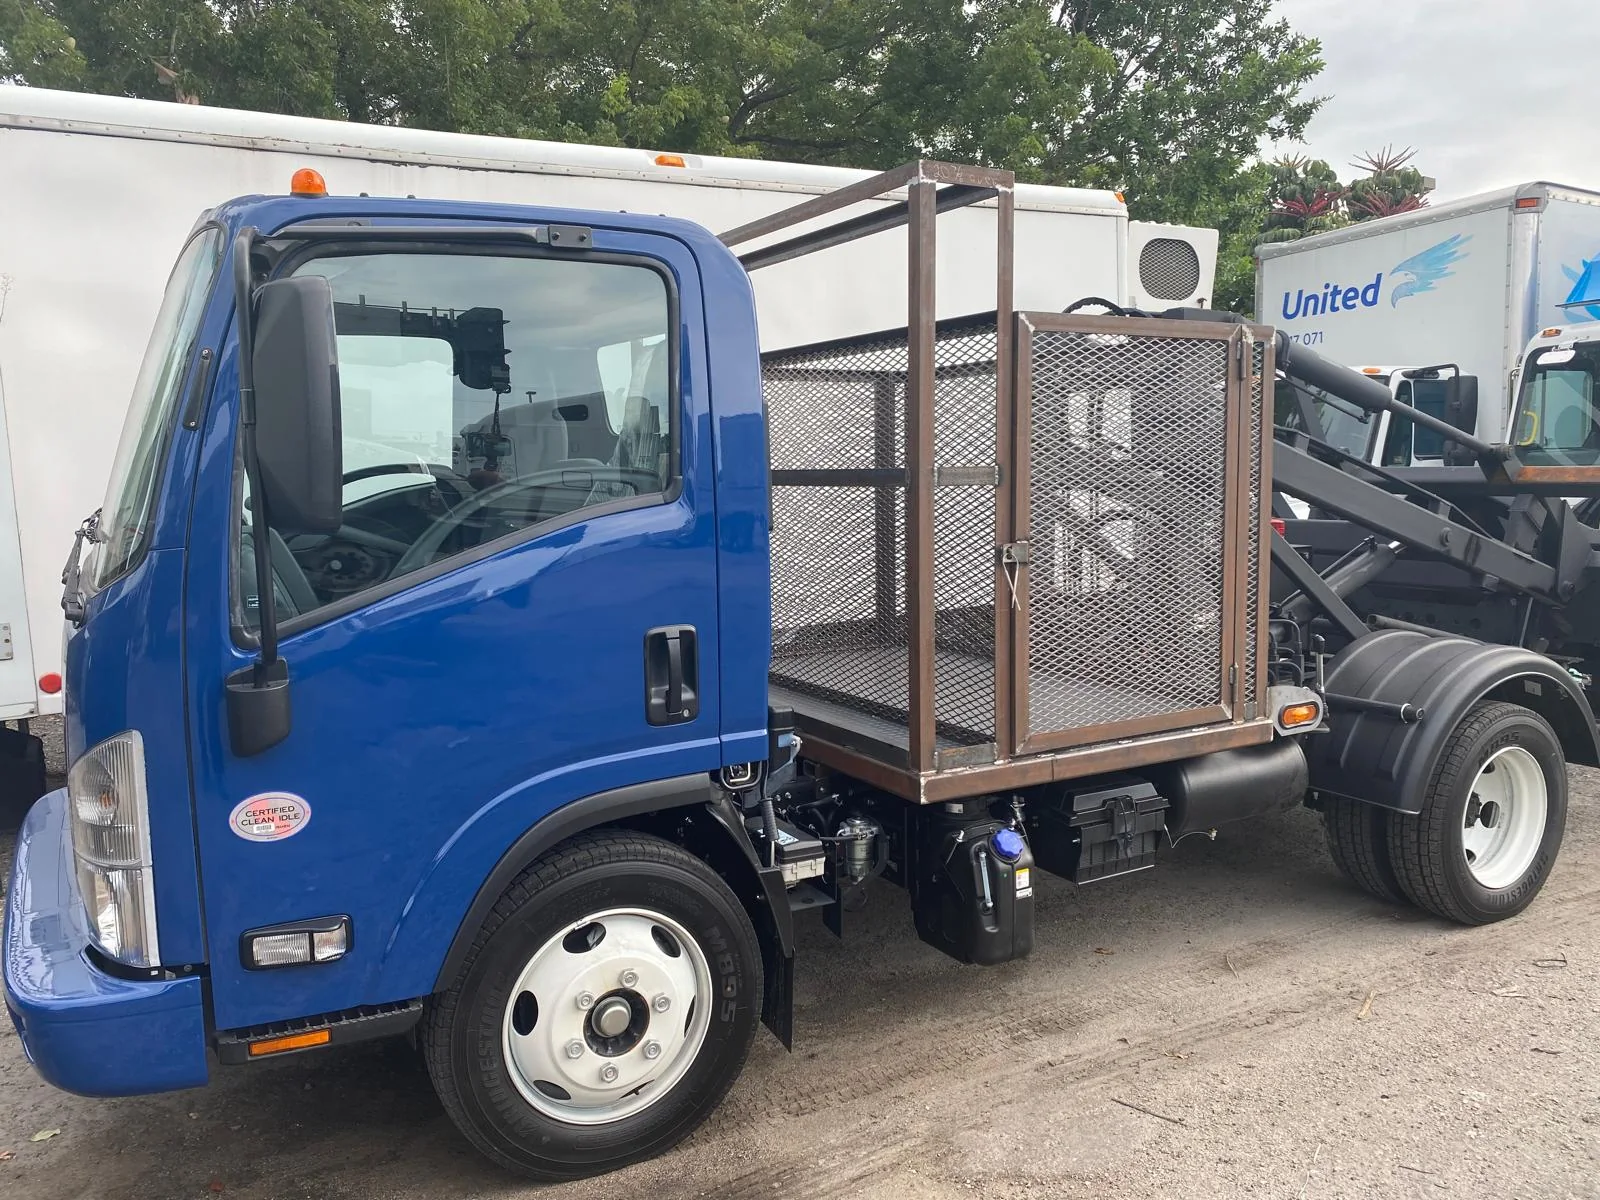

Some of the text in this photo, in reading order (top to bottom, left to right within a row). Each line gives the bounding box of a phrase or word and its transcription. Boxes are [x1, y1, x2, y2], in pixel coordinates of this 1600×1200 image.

[1282, 272, 1383, 320] United
[1303, 331, 1323, 345] 071
[245, 805, 295, 818] CERTIFIED
[241, 812, 300, 826] CLEAN IDLE
